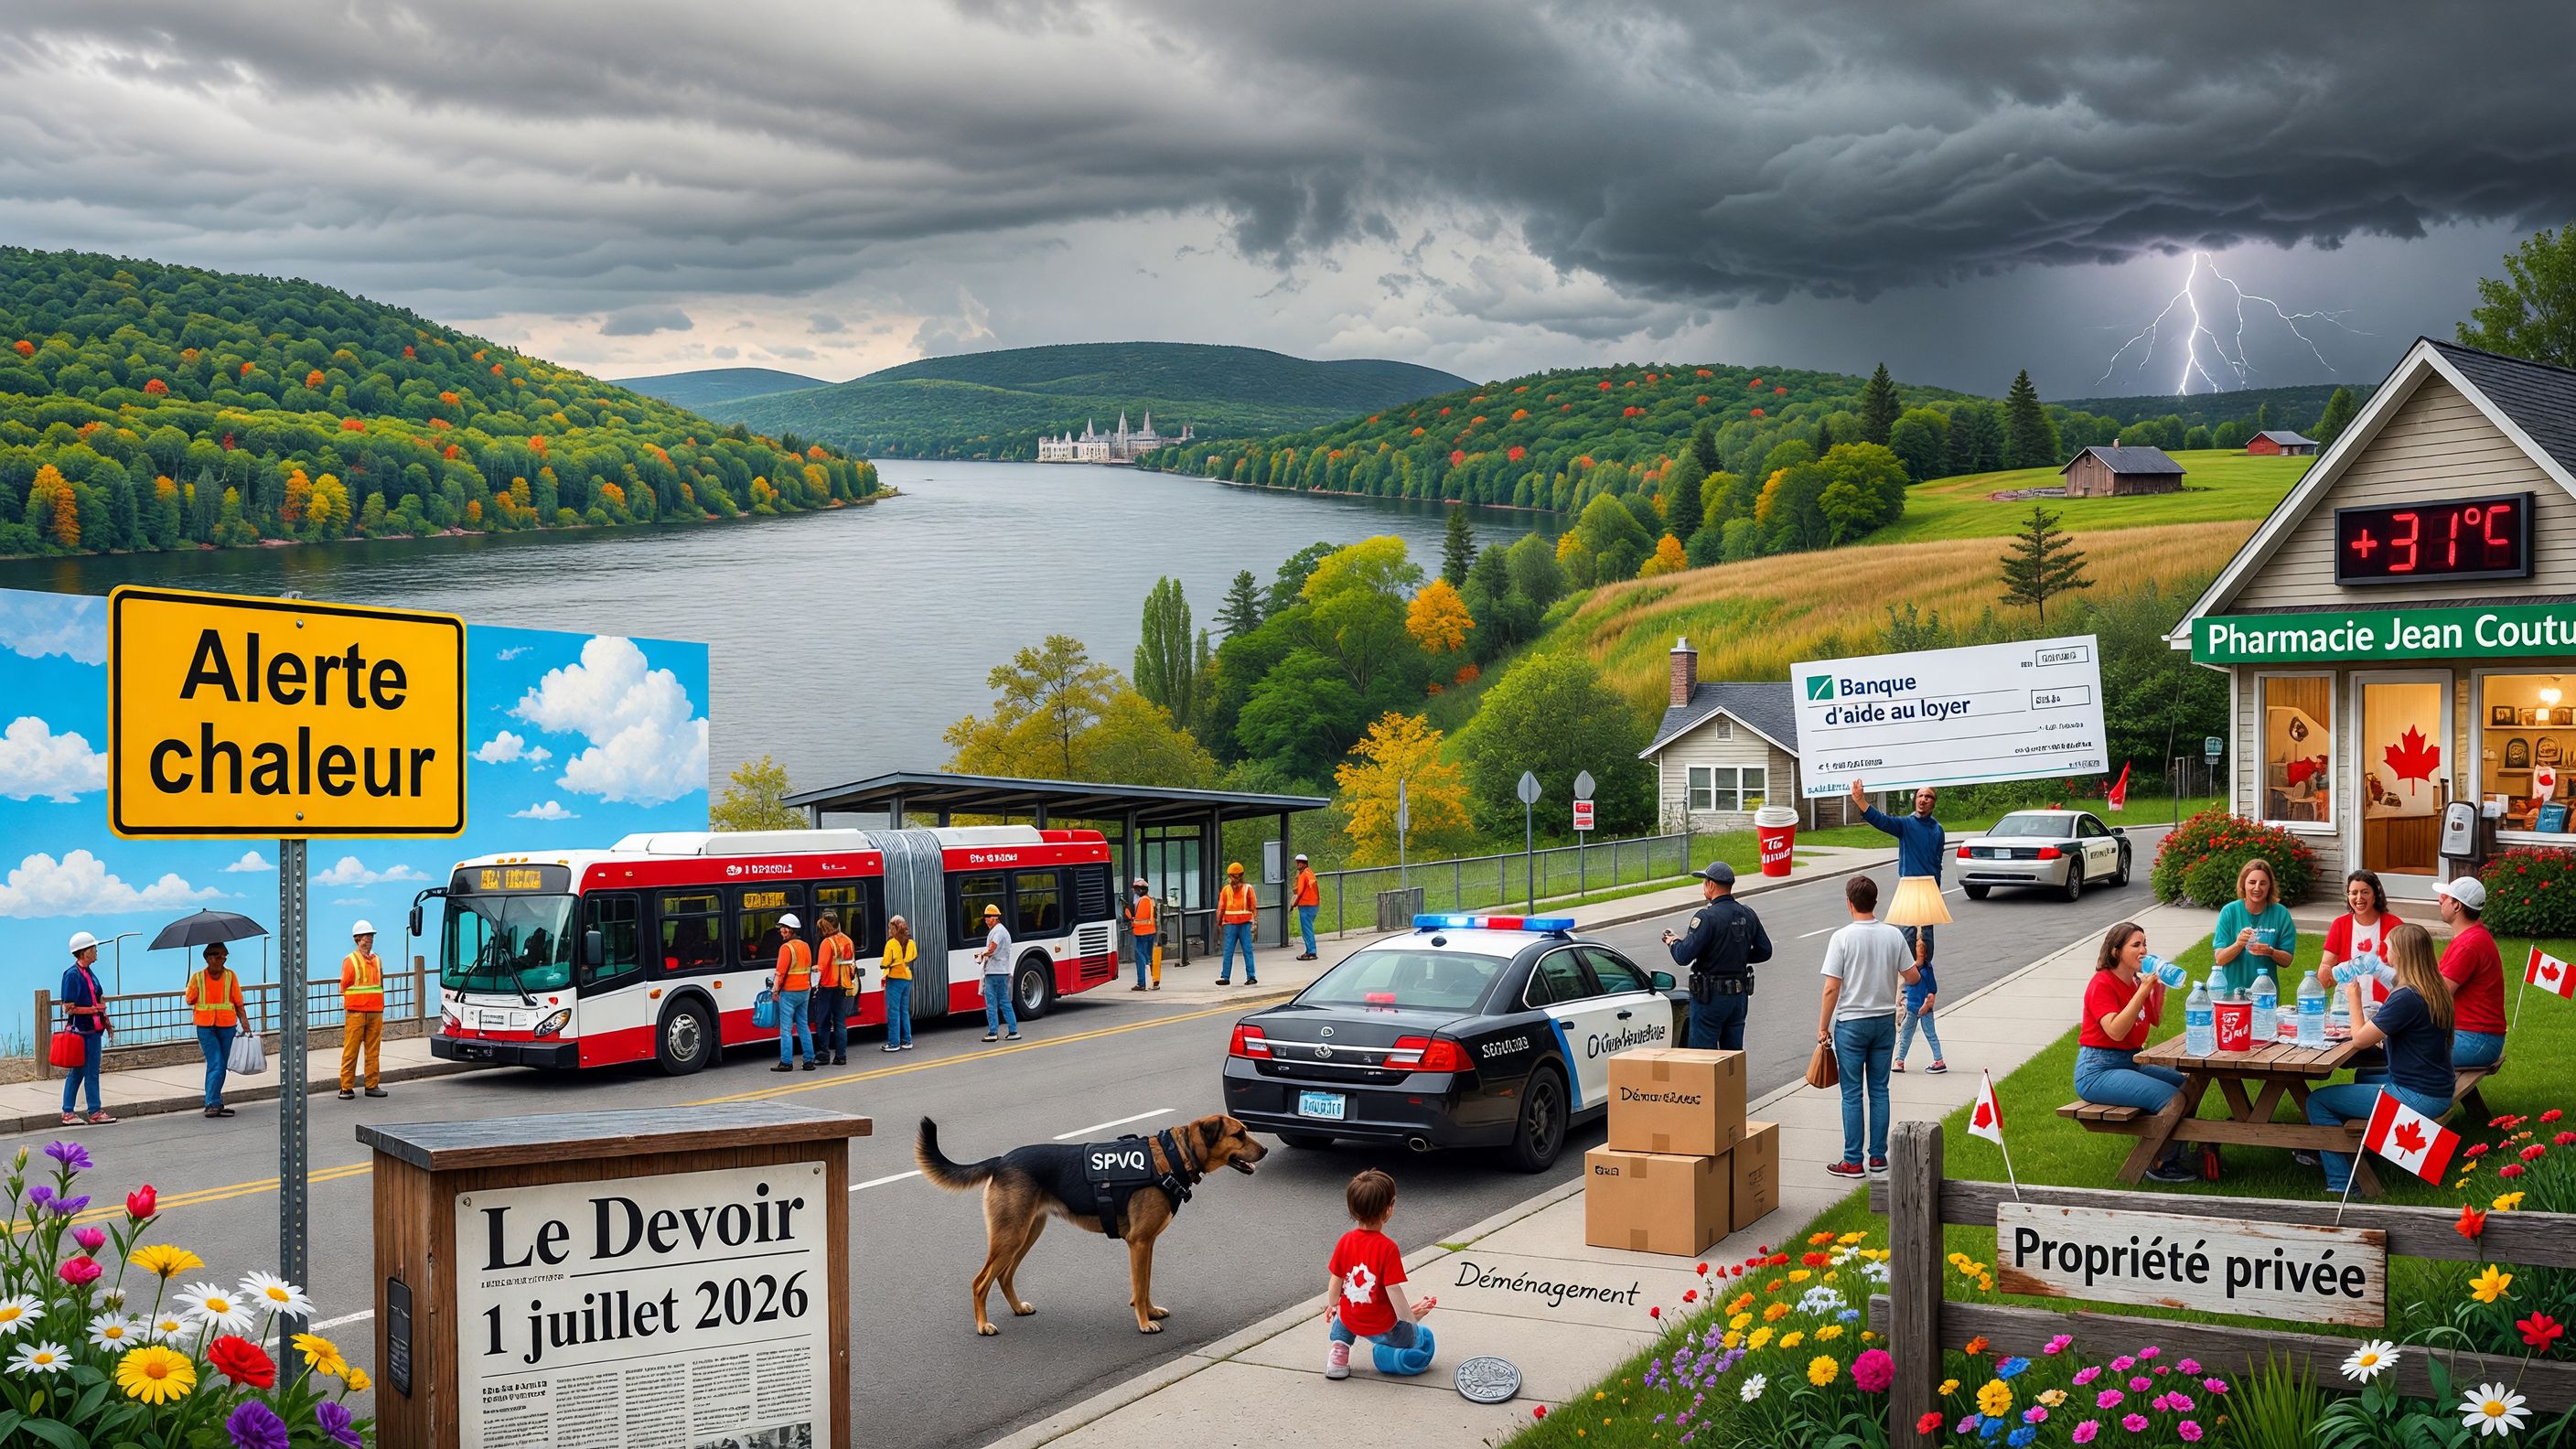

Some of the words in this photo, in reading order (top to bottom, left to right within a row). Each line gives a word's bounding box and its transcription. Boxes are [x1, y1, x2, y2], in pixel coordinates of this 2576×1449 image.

[2208, 620, 2375, 655] Pharmacie
[2385, 617, 2463, 650] Jean
[2474, 614, 2576, 648] Coutu
[180, 628, 408, 711] Alerte
[1840, 675, 1917, 698] Banque
[1825, 703, 1885, 725] d'aide
[1891, 705, 1916, 720] au
[1920, 698, 1971, 722] loyer
[149, 722, 436, 798] chaleur
[1090, 1151, 1145, 1171] SPVQ
[479, 1206, 571, 1272] Le
[588, 1182, 805, 1261] Devoir
[1454, 1261, 1641, 1308] Déménagement
[2014, 1227, 2210, 1287] Propriété
[2226, 1248, 2367, 1299] privée
[482, 1304, 509, 1357] 1
[523, 1287, 682, 1365] juillet
[694, 1269, 810, 1330] 2026
